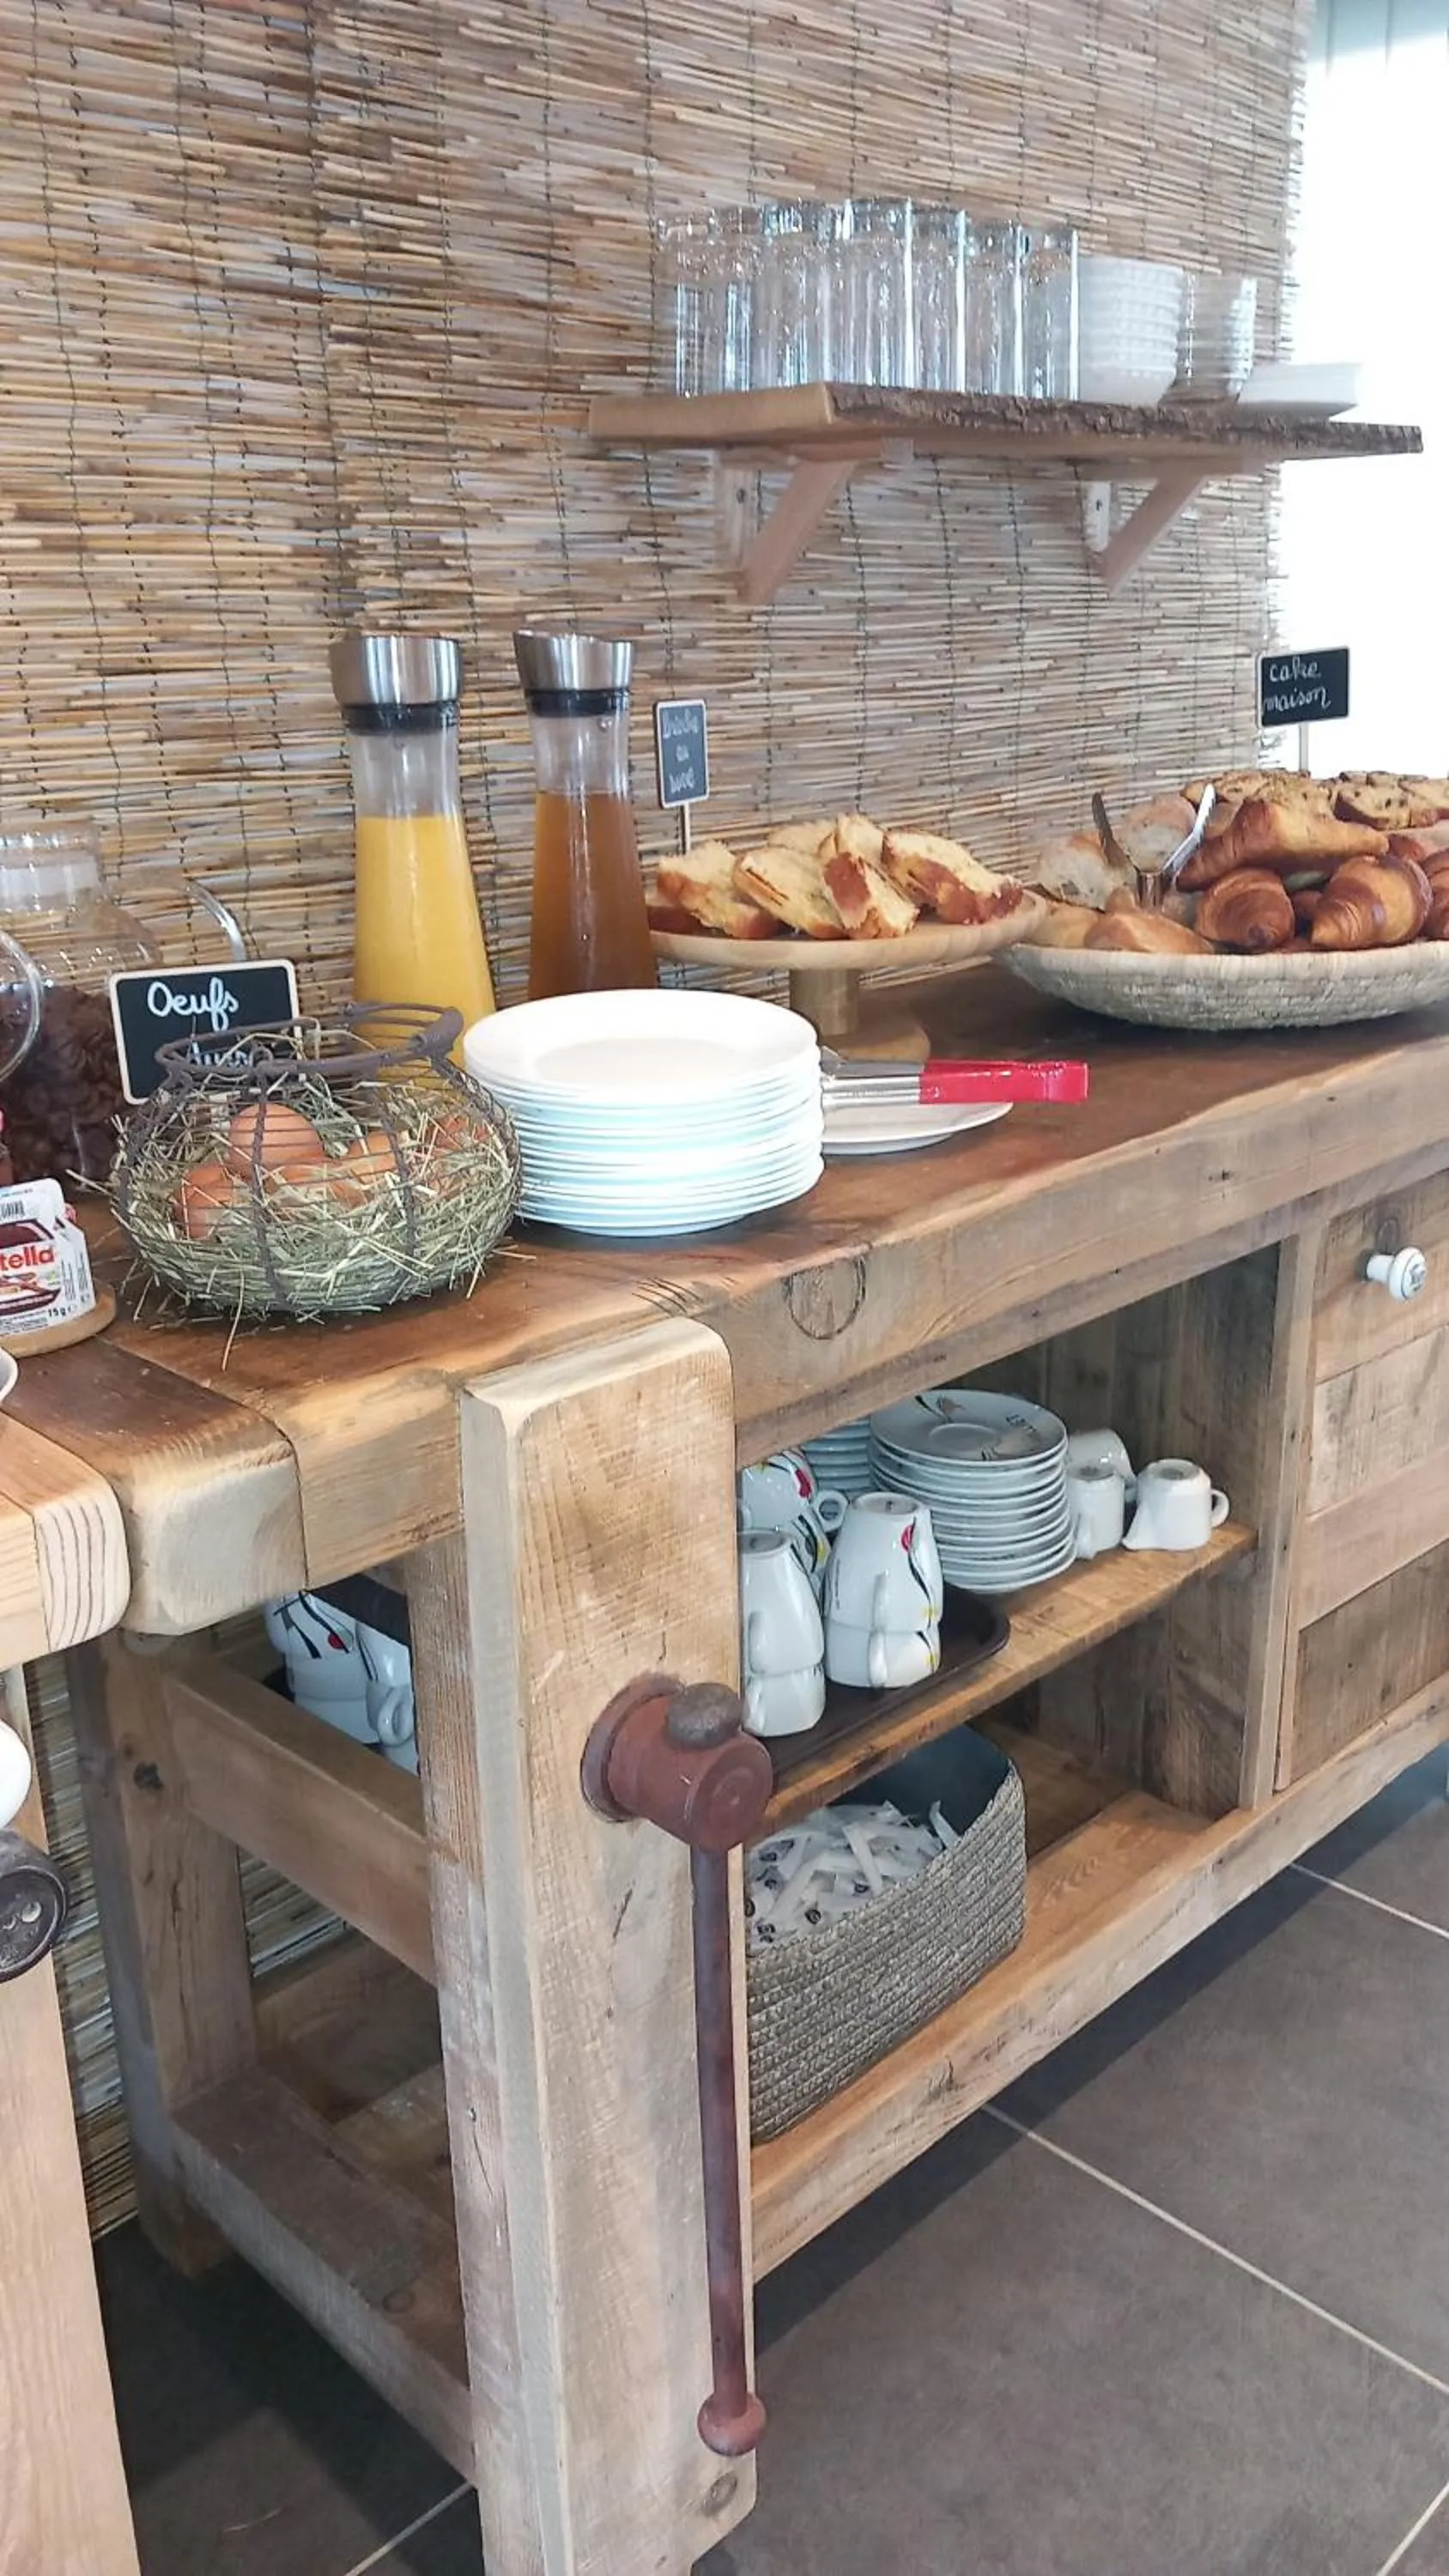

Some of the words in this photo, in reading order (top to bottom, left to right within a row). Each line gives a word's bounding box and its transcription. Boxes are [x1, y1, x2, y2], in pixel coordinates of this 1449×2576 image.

[1270, 655, 1321, 682] cake
[1264, 687, 1331, 712] maison
[147, 976, 239, 1031] Oeufs
[0, 1244, 55, 1271] tella
